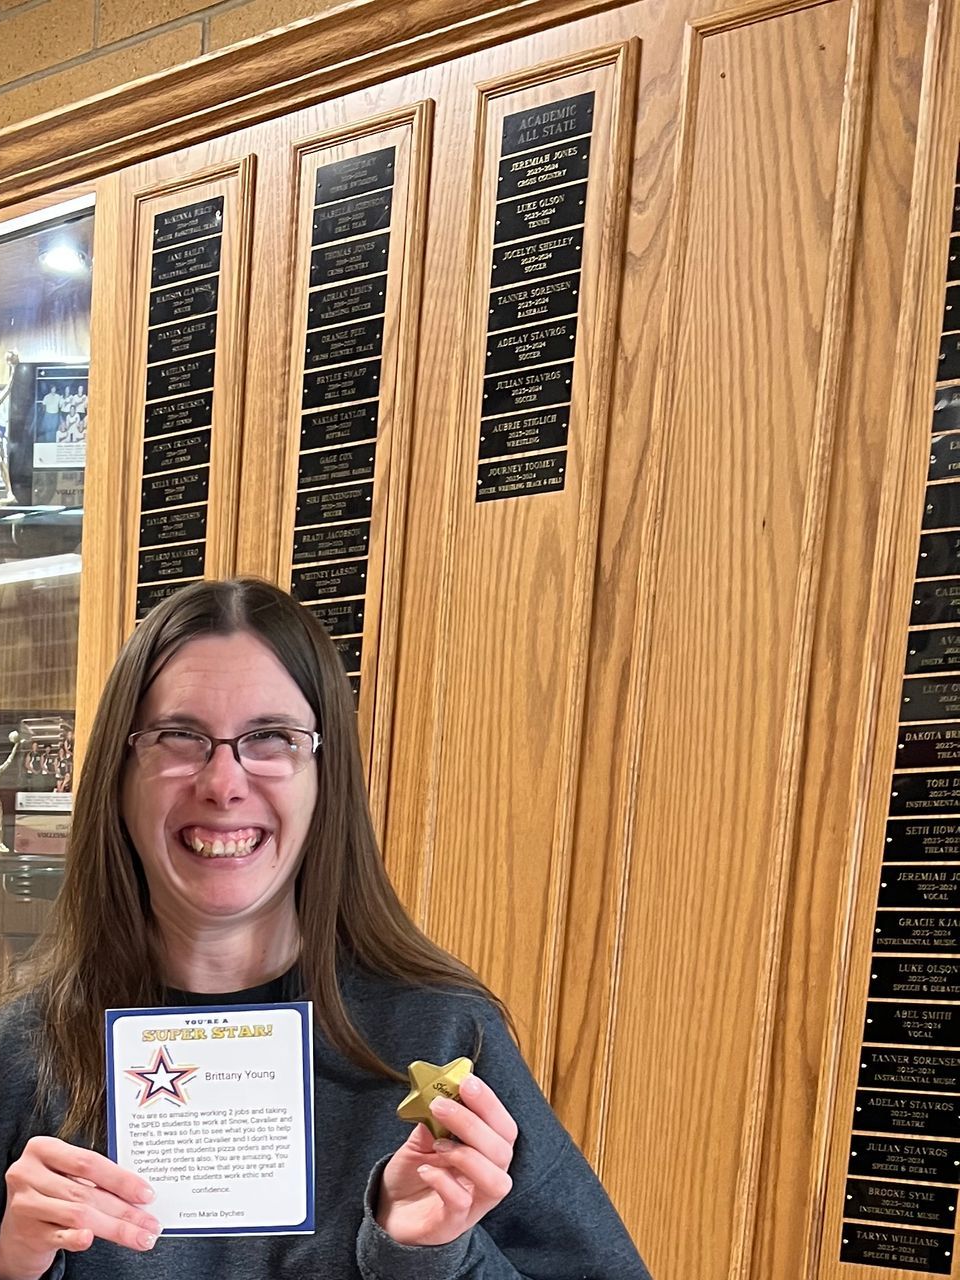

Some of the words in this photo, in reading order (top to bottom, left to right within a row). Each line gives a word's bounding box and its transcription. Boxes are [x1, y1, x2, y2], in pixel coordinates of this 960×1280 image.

[519, 105, 577, 131] ACADEMIC
[518, 132, 539, 144] ALL
[542, 119, 576, 138] STATE
[510, 154, 551, 171] JEREMIAH
[553, 147, 578, 160] JONES
[538, 169, 567, 183] COUNTRY
[517, 202, 537, 214] LUKE
[539, 194, 565, 210] OLSON
[502, 245, 536, 260] JOCELYN
[538, 236, 573, 253] SHELLEY
[497, 289, 529, 305] TANNER
[531, 281, 572, 297] SORENSEN
[497, 332, 529, 348] ADELAY
[530, 326, 566, 342] STAVROS
[495, 376, 524, 390] JULIAN
[526, 371, 561, 386] STAVROS
[493, 420, 521, 433] AUBRIE
[523, 415, 557, 429] STIGLICH
[488, 462, 519, 477] JOURNEY
[521, 459, 556, 473] TOOMEY
[905, 732, 941, 741] DAKOTA
[927, 779, 949, 788] TORI
[905, 826, 929, 835] SETH
[897, 873, 946, 881] JEREMIAH
[898, 917, 935, 927] GRACIE
[899, 964, 924, 973] LUKE
[927, 964, 960, 974] OLSON
[894, 1010, 920, 1019] ABEL
[922, 1011, 952, 1020] SMITH
[142, 1028, 207, 1042] SUPER
[211, 1024, 273, 1039] STAR!
[872, 1054, 909, 1064] TANNER
[913, 1055, 960, 1066] SORENSEN
[205, 1072, 242, 1081] Brittany
[244, 1071, 275, 1079] Young
[874, 1074, 930, 1084] INSTRUMENTAL
[933, 1077, 956, 1085] MUSIC
[868, 1098, 907, 1108] ADELAY
[909, 1101, 954, 1111] STAVROS
[234, 1108, 249, 1116] jobs
[892, 1119, 925, 1128] THEATRE
[866, 1143, 900, 1153] JULIAN
[903, 1146, 948, 1157] STAVROS
[137, 1166, 168, 1174] definitely
[872, 1163, 899, 1171] SPEECH
[909, 1166, 937, 1174] DEBATE
[868, 1187, 906, 1198] BROOKE
[909, 1190, 935, 1201] SYME
[220, 1210, 244, 1218] Dyches
[860, 1206, 914, 1218] INSTRUMENTAL
[917, 1211, 940, 1220] MUSIC
[856, 1231, 889, 1240] TARYN
[891, 1234, 939, 1247] WILLIAMS
[863, 1250, 889, 1260] SPEECH
[900, 1255, 928, 1265] DEBATE
